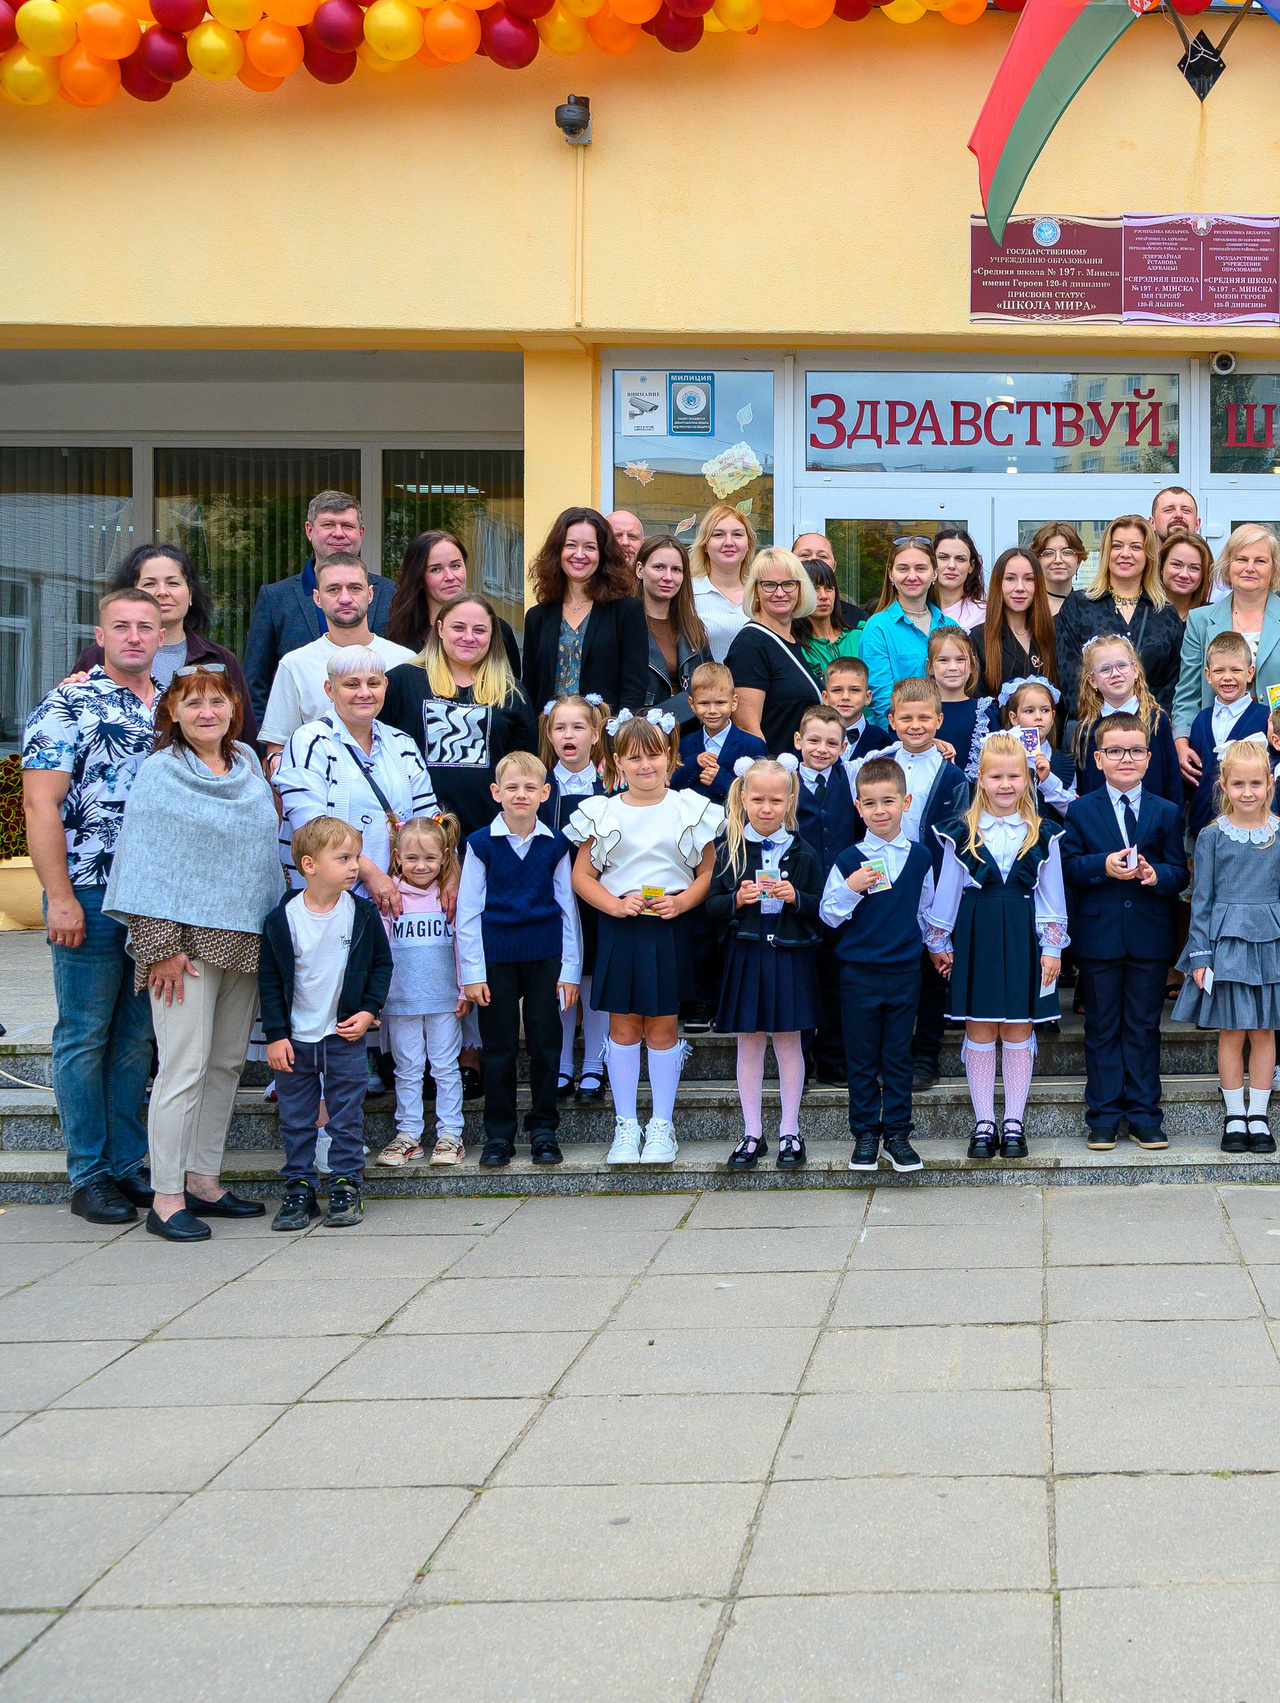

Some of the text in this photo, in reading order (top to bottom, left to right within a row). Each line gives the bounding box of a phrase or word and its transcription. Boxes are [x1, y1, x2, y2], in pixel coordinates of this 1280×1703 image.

[1006, 248, 1088, 256] ГОСУДАРСТВЕННОМУ
[989, 256, 1103, 265] УЧРЕЖДЕНИЮ ОБРАЗОВАНИЯ
[972, 267, 1014, 277] «Средняя
[1047, 268, 1057, 276] №
[1059, 267, 1076, 276] 197
[1086, 268, 1120, 277] Минска
[1012, 279, 1043, 288] Героев
[1045, 279, 1068, 287] 120-й
[1054, 291, 1086, 299] СТАТУС
[996, 300, 1097, 311] «ШКОЛА МИРА»
[810, 388, 1178, 457] ЗДРАВСТВУЙ,
